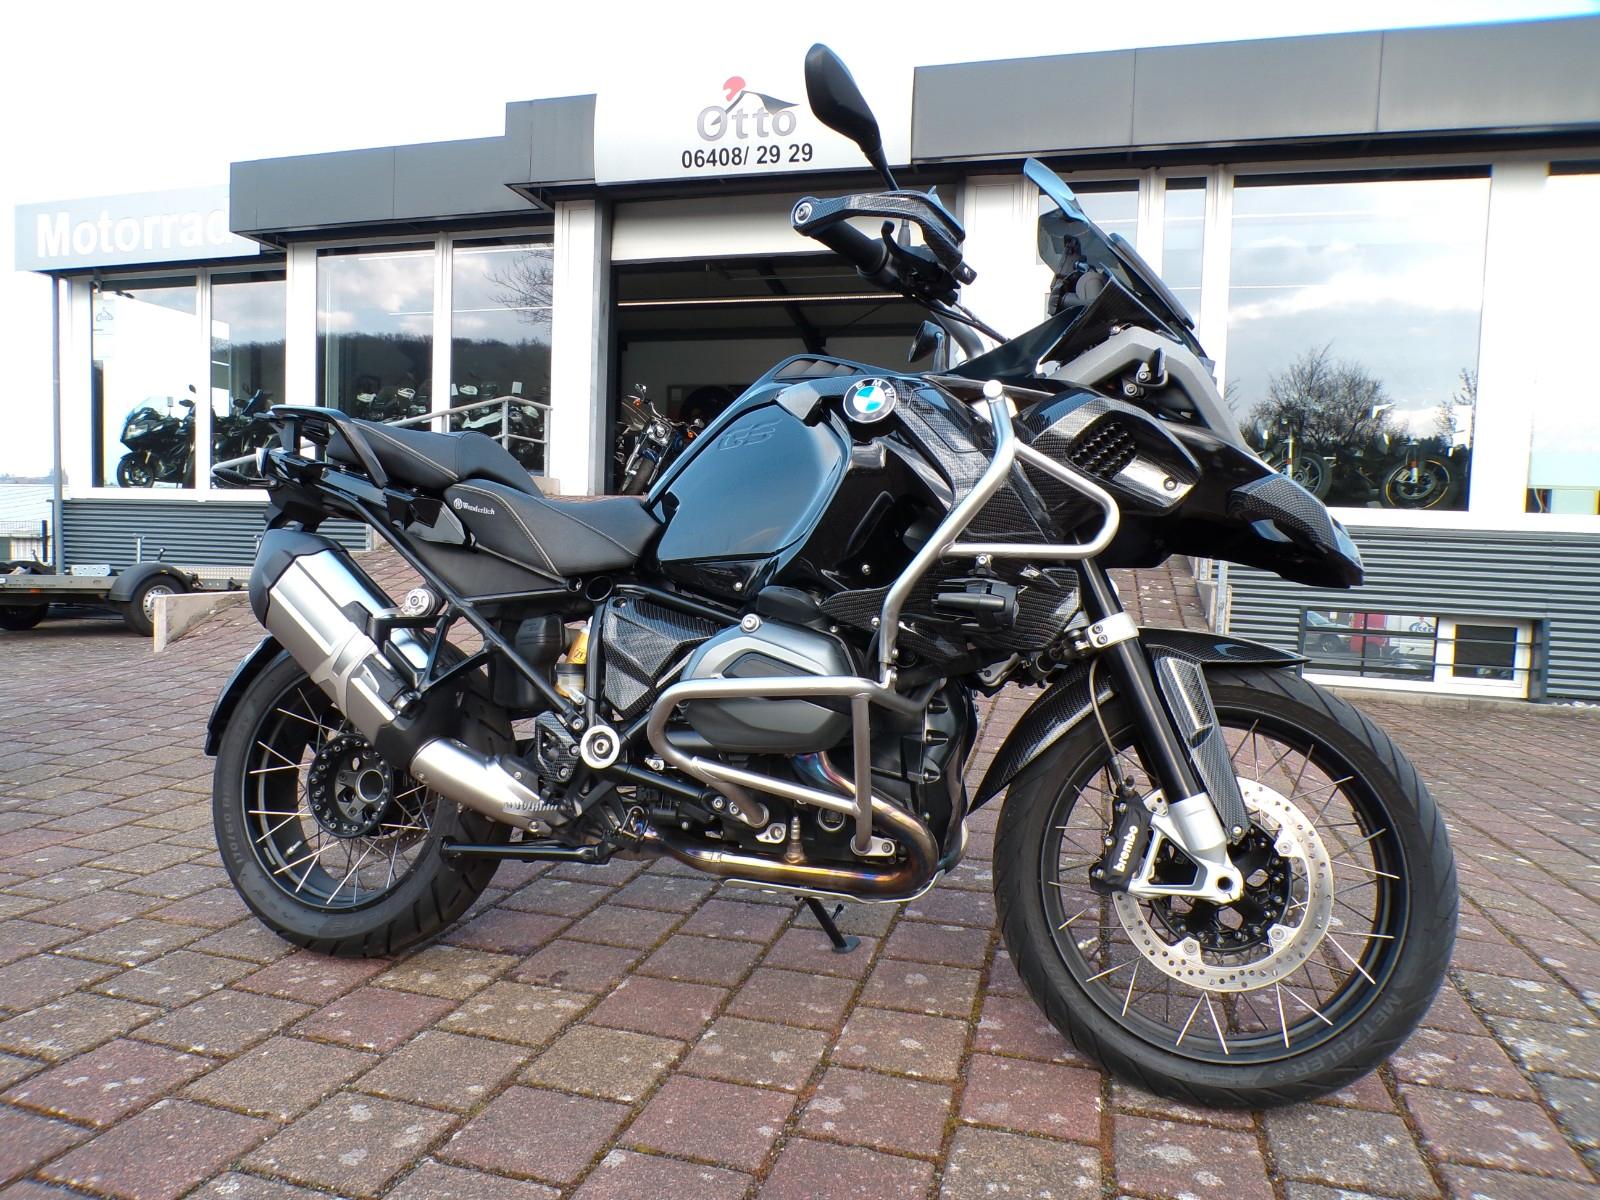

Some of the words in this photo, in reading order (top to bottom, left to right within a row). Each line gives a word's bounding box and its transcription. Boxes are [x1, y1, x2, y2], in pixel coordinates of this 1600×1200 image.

[697, 105, 797, 142] Otto
[682, 146, 749, 168] 06408/
[757, 145, 781, 164] 29
[789, 143, 813, 163] 29
[36, 208, 234, 258] Motorrad
[718, 418, 783, 451] GS
[1113, 825, 1138, 873] brembo
[1292, 993, 1401, 1078] METZELER
